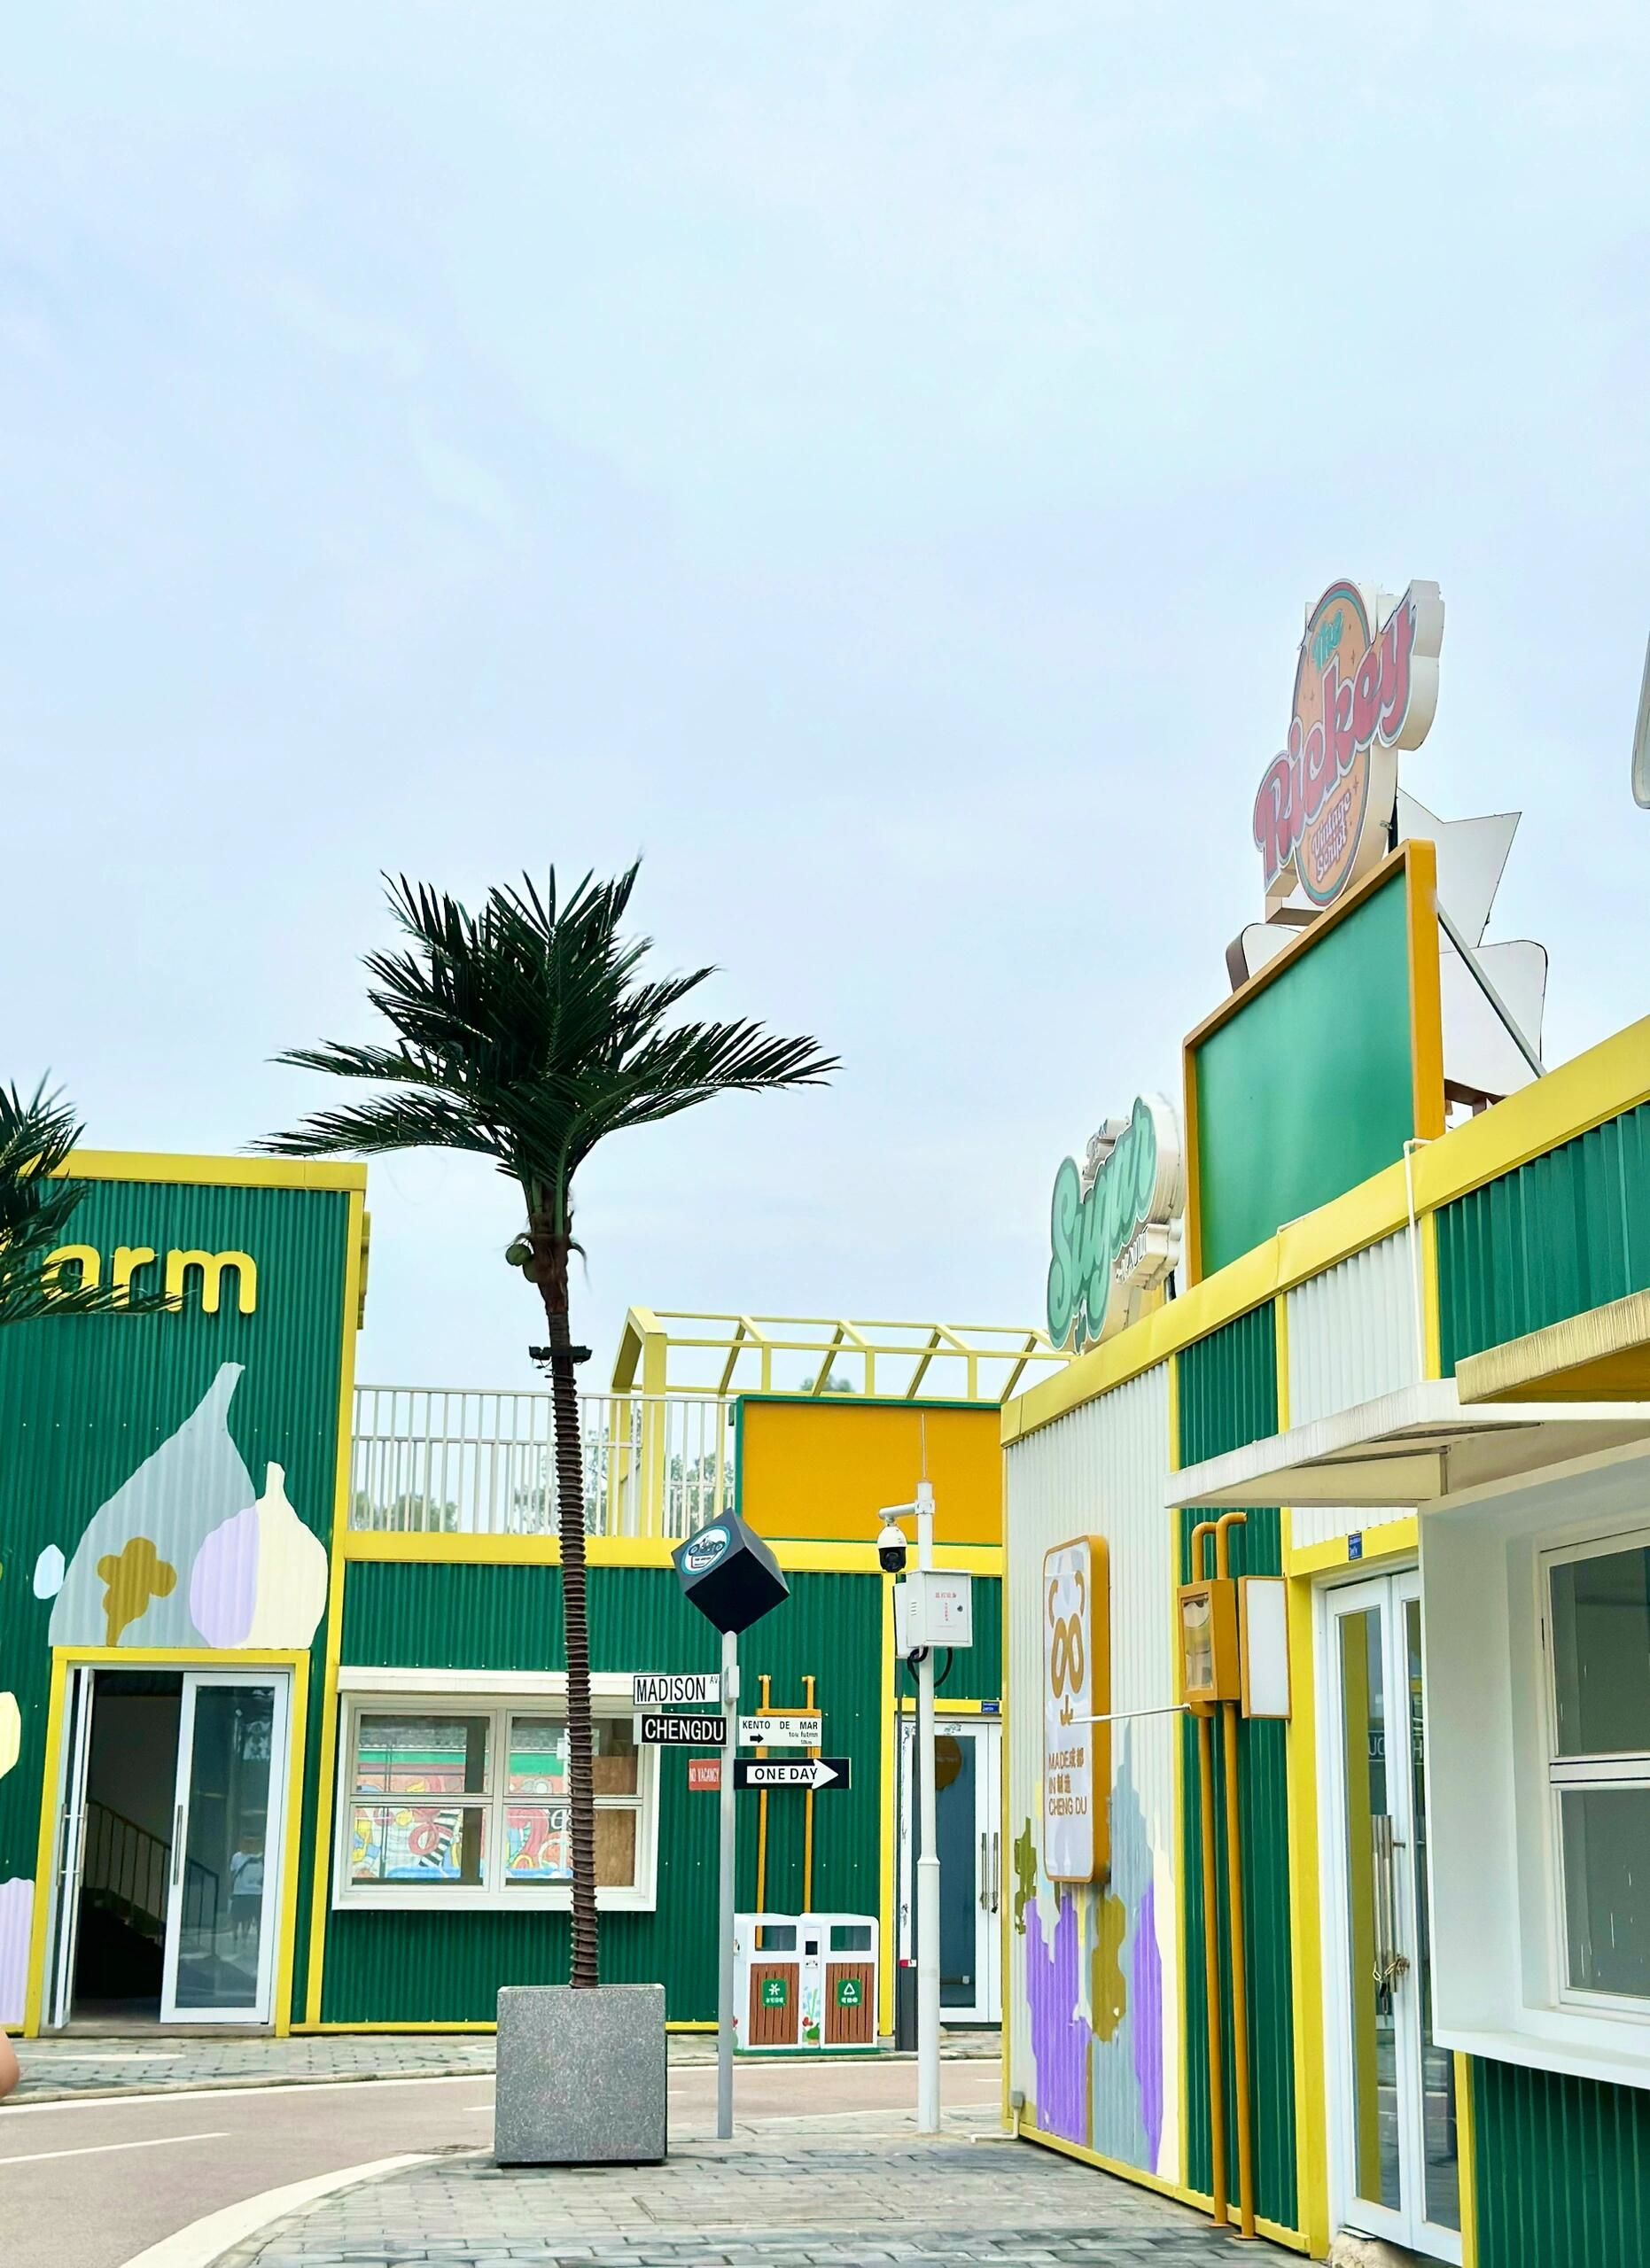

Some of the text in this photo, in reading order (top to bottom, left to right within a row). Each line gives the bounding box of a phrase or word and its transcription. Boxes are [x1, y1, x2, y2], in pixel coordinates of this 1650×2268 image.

[1254, 600, 1416, 884] Rickey
[1047, 1096, 1156, 1350] Sugar
[0, 1231, 258, 1314] arm
[637, 1676, 706, 1702] MADISON
[644, 1718, 724, 1741] CHENGDU
[743, 1720, 770, 1729] KENTO
[780, 1720, 790, 1729] DE
[1048, 1751, 1069, 1769] MADE
[754, 1767, 818, 1780] ONE DAY
[1048, 1776, 1055, 1794] IN
[1048, 1796, 1087, 1815] CHENG DU
